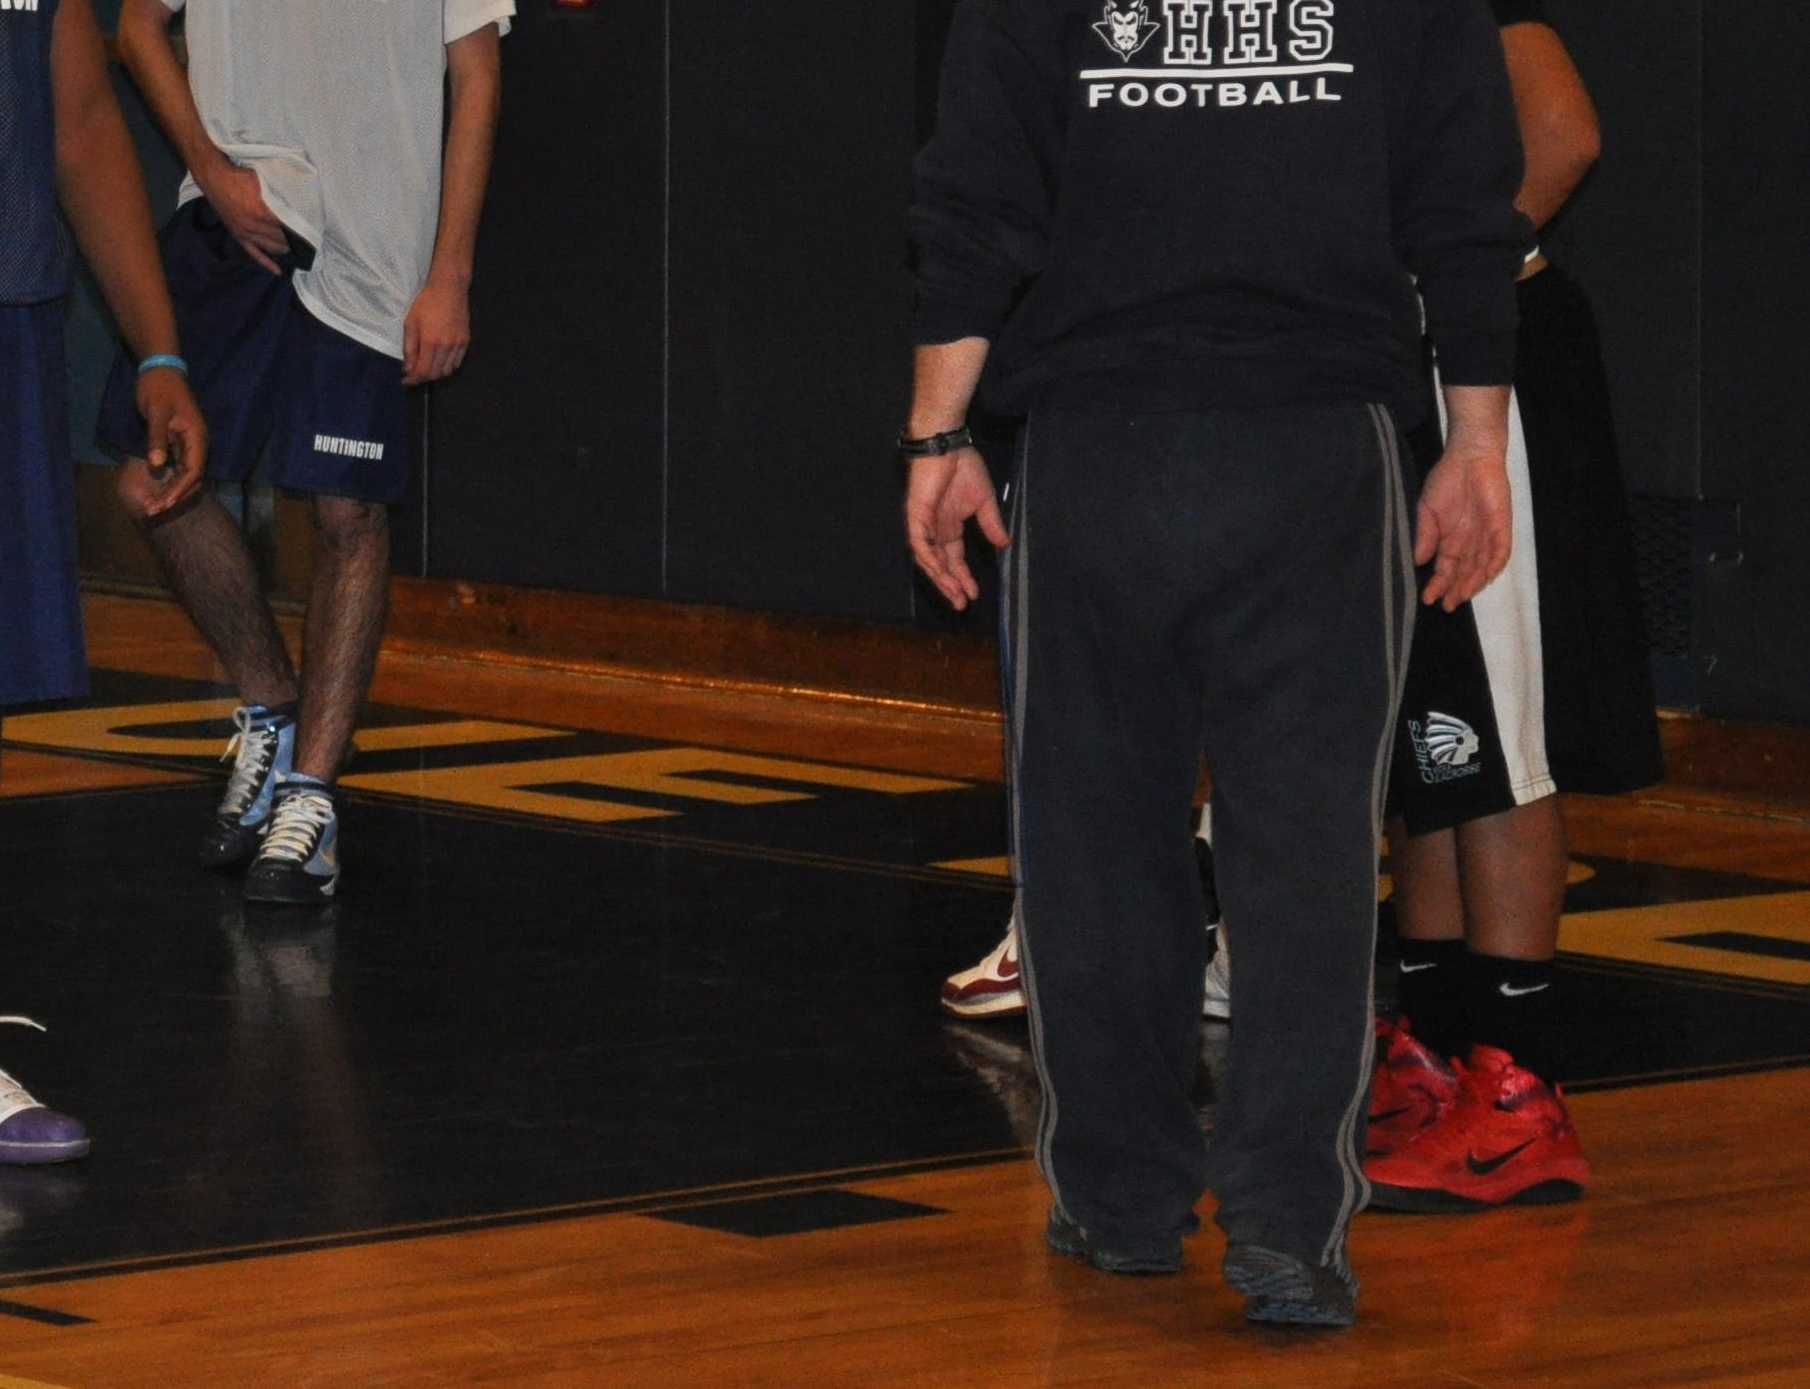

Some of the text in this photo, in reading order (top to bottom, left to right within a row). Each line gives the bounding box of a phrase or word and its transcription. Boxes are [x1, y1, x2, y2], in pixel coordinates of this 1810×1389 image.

[1088, 76, 1342, 108] FOOTBALL
[313, 433, 385, 461] HUNTINGTON
[1408, 719, 1435, 784] CHIEFS
